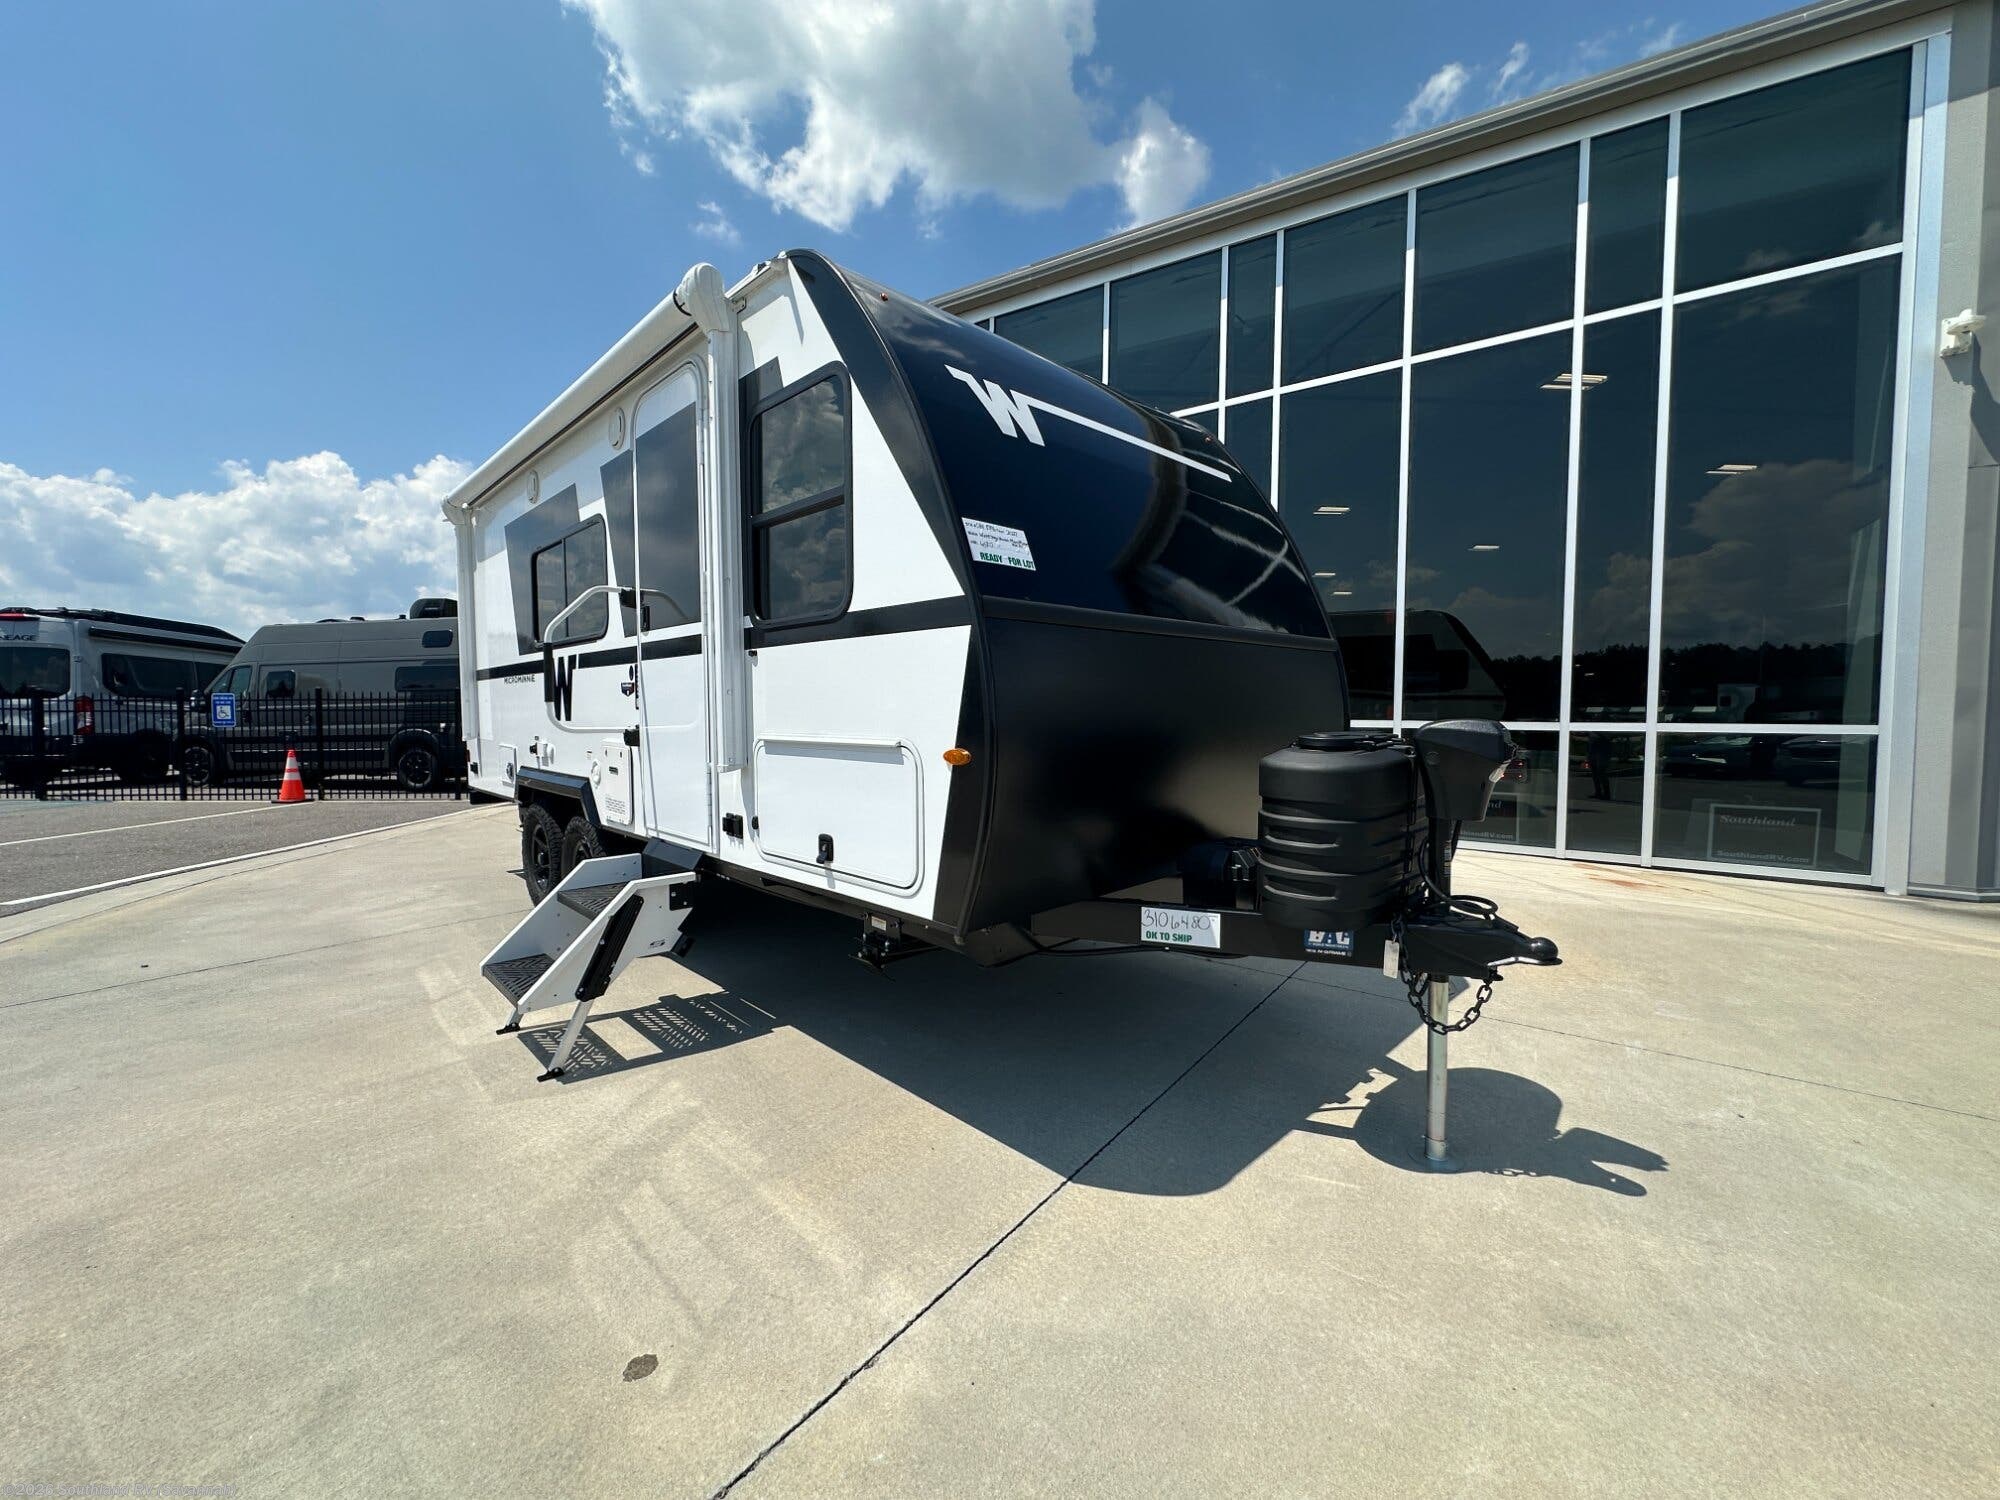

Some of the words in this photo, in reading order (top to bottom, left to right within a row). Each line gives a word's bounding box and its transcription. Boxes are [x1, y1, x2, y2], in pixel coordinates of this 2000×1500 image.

[980, 552, 1002, 563] READY
[1008, 556, 1022, 566] FOR
[1023, 560, 1034, 569] LOT
[1719, 814, 1796, 826] Southland
[1716, 850, 1809, 863] SouthlandRV.com
[1146, 931, 1157, 939] OK
[1160, 932, 1170, 941] TO
[1172, 933, 1192, 943] SHIP
